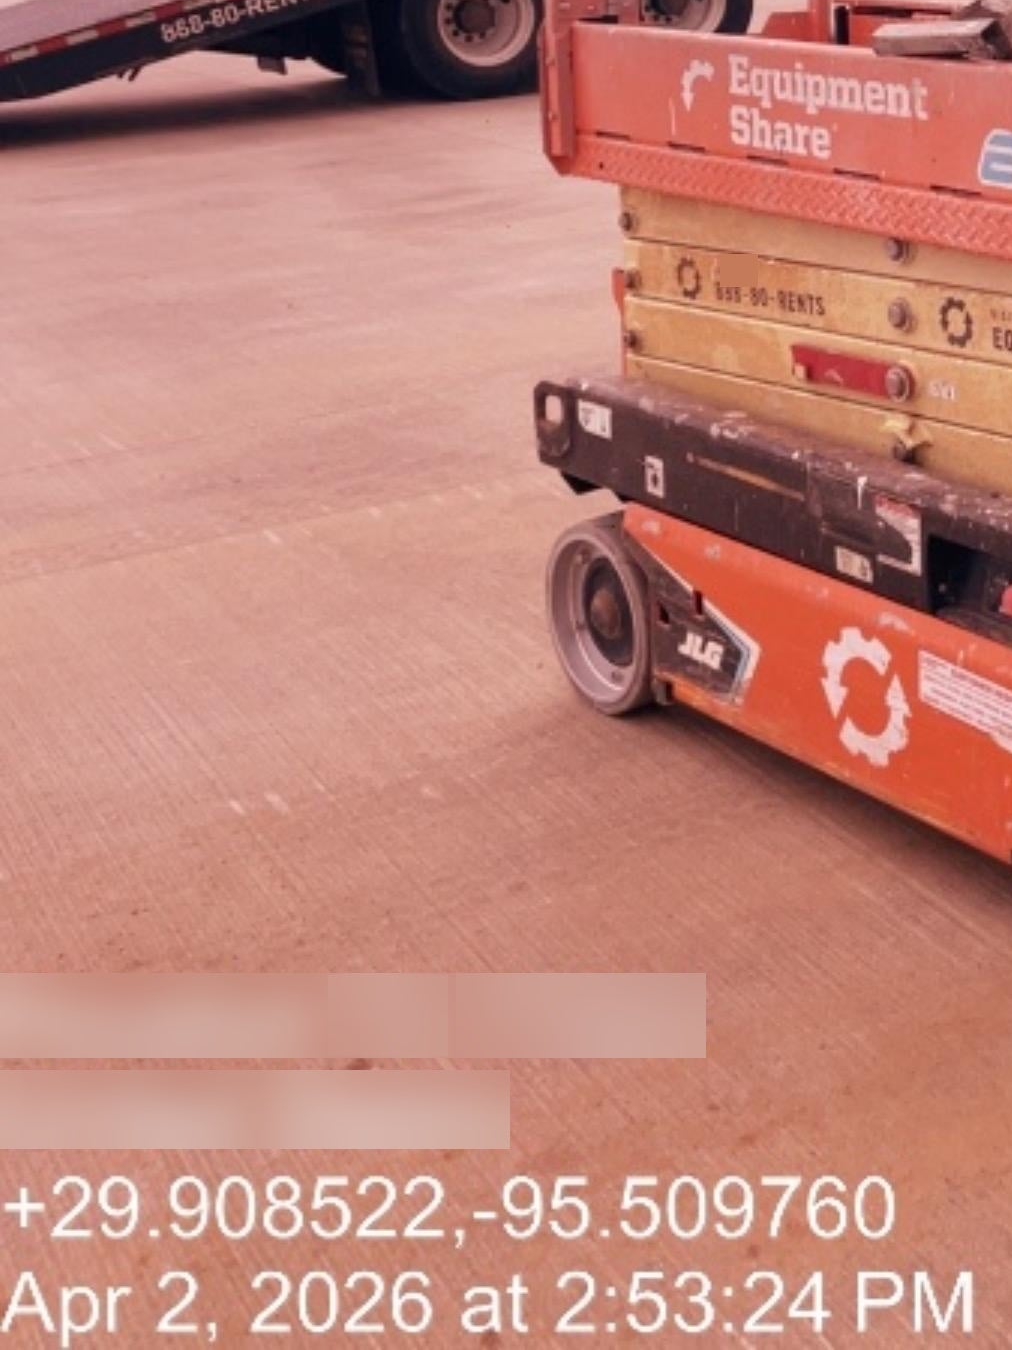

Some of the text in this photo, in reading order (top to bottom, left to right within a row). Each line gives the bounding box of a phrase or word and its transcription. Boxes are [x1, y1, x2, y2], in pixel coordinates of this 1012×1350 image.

[727, 54, 929, 120] Equipment
[730, 106, 832, 160] Share
[678, 632, 724, 670] JLG
